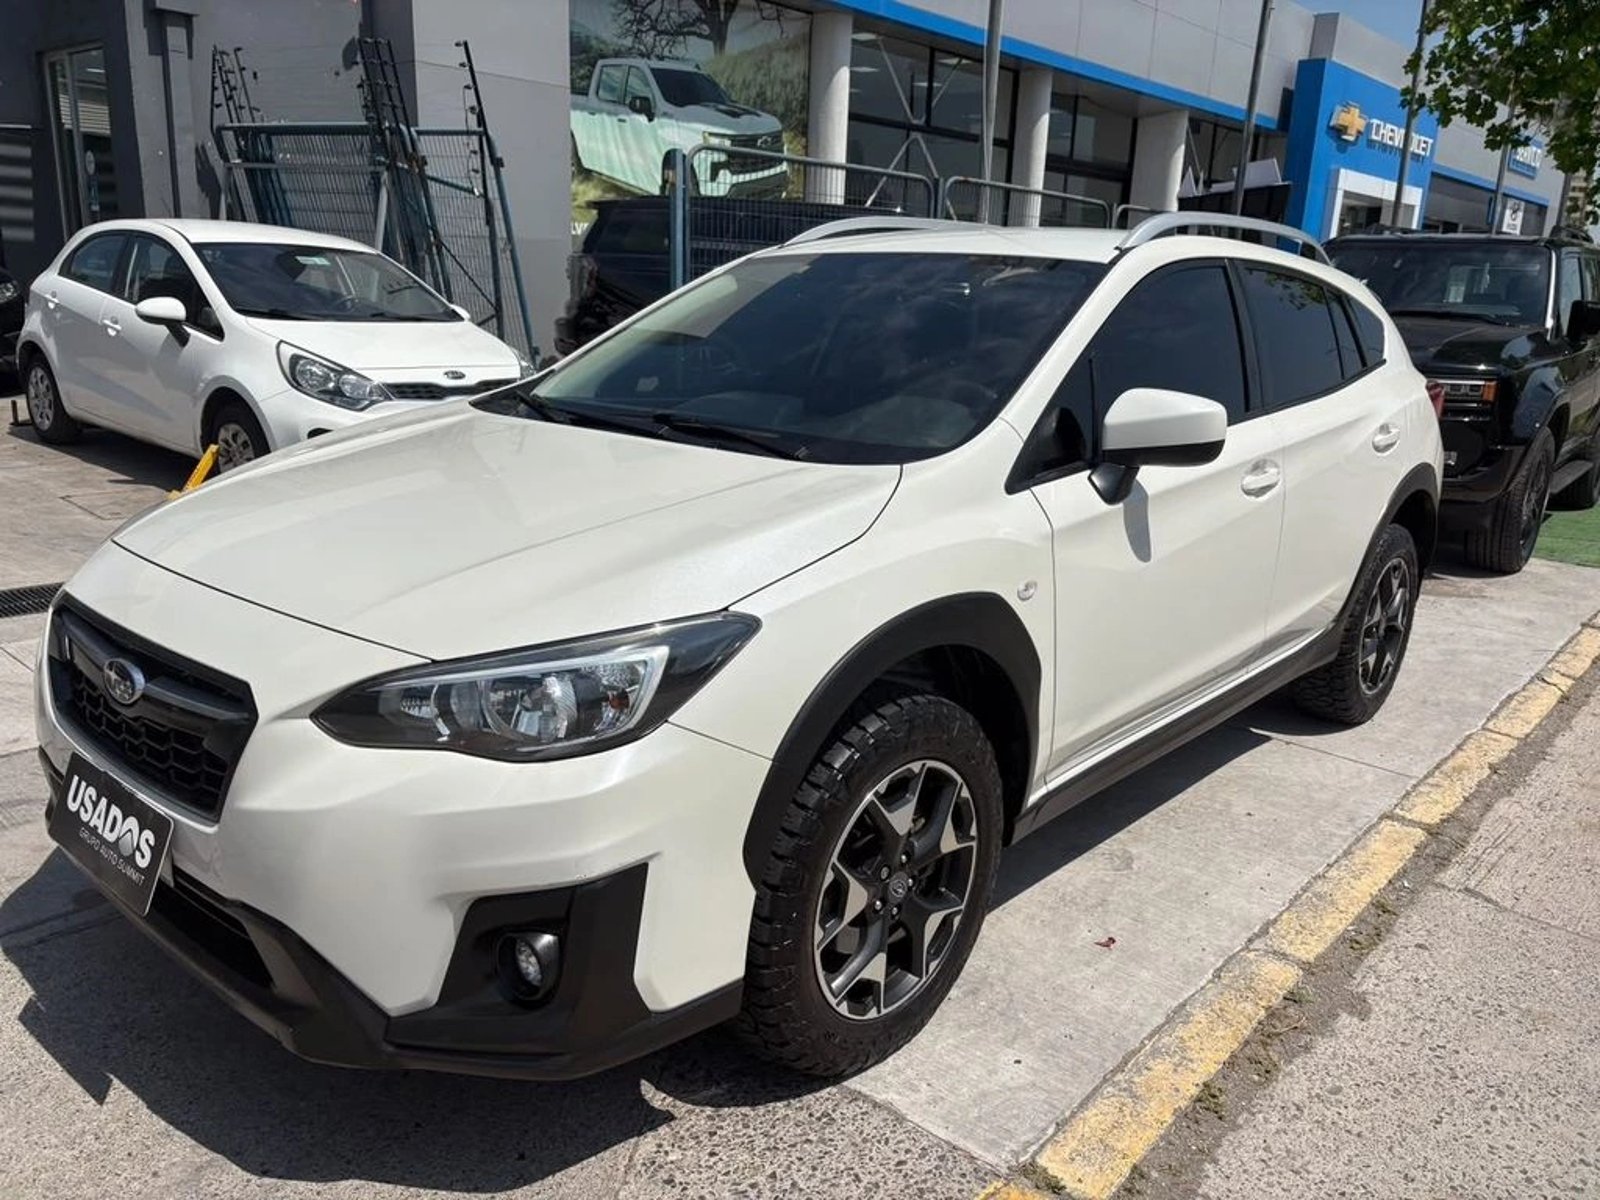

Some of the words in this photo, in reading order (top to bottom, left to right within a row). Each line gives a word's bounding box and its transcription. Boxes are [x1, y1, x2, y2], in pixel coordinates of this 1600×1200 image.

[1370, 118, 1433, 157] CHEVOLET
[67, 775, 155, 868] USADOS
[79, 827, 101, 850] GRUPO
[99, 844, 118, 865] AUTO
